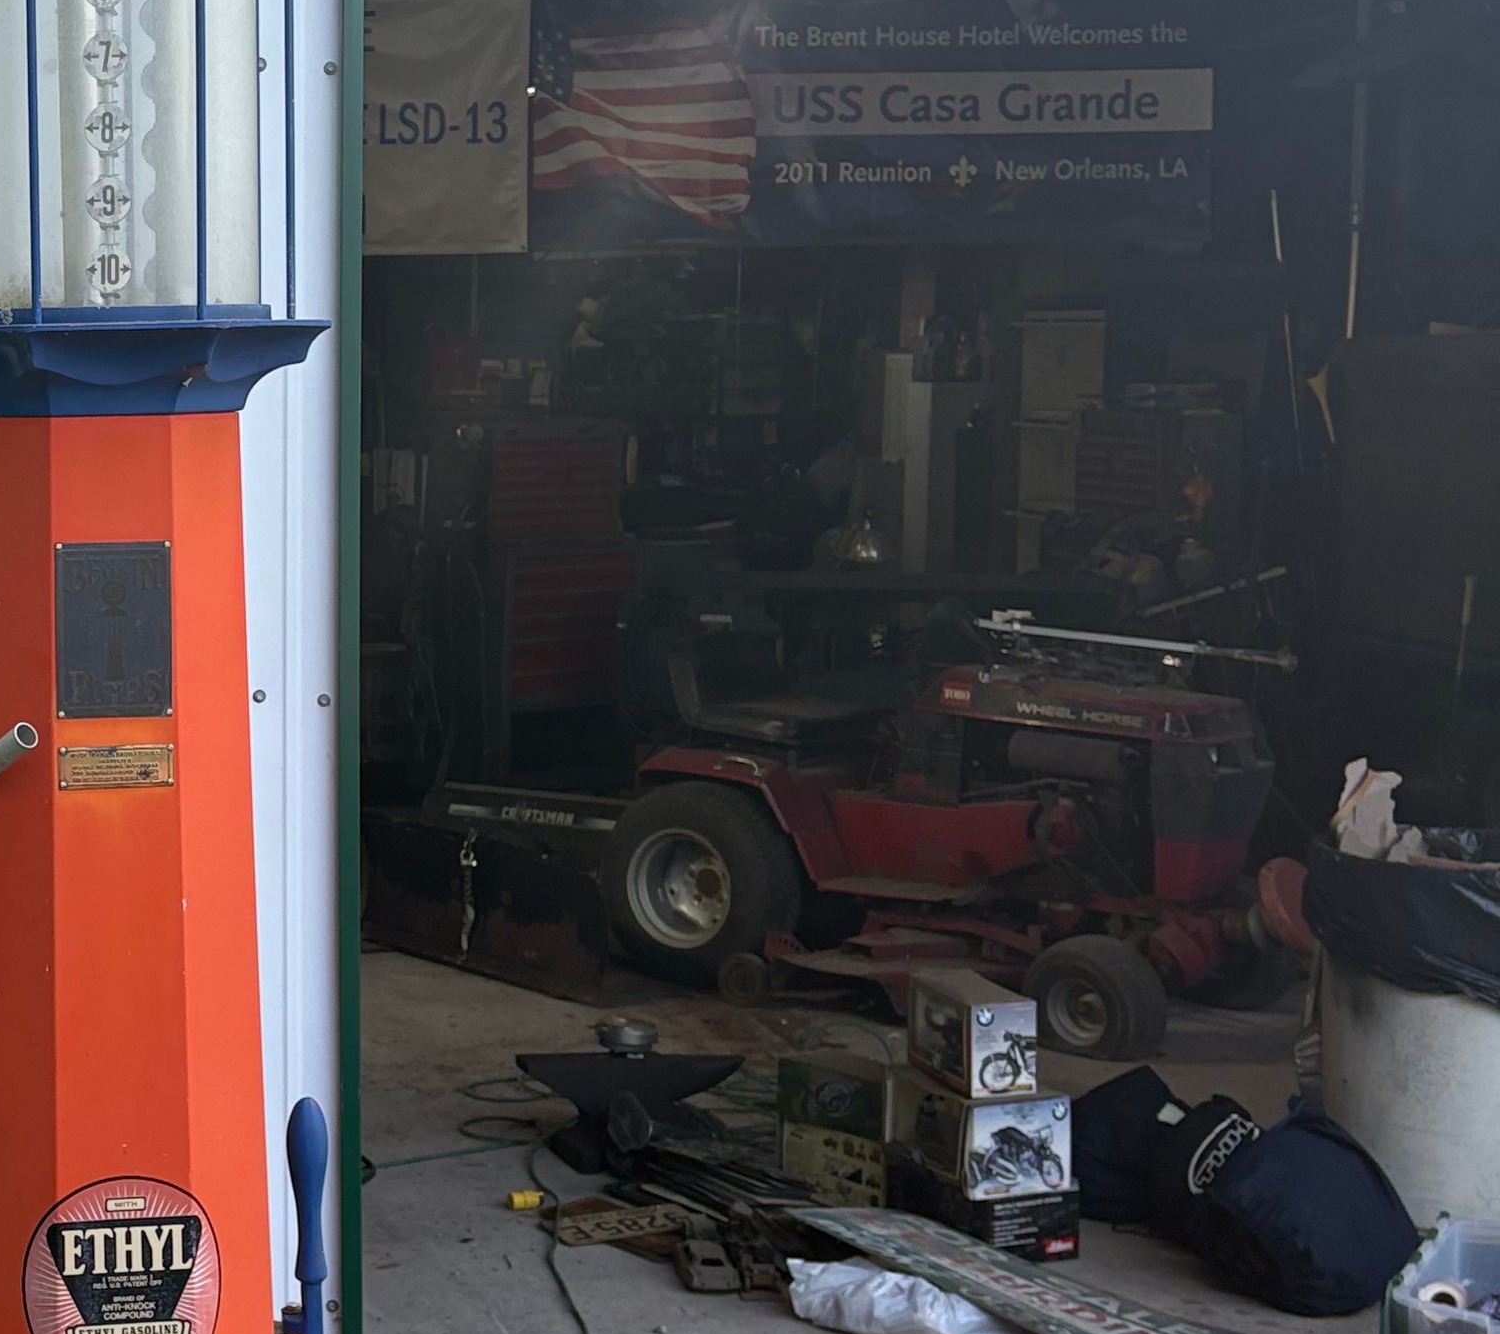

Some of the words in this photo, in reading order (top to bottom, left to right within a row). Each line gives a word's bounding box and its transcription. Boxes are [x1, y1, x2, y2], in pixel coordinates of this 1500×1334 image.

[755, 25, 799, 47] The
[807, 26, 867, 47] Brent
[876, 25, 950, 46] House
[959, 23, 1020, 46] Hotel
[1027, 22, 1143, 45] Welcomes
[1151, 21, 1188, 44] the
[99, 40, 112, 73] 7
[774, 84, 864, 124] USS
[880, 84, 981, 123] Casa
[998, 78, 1160, 122] Grande
[100, 111, 114, 144] 8
[379, 100, 508, 145] LSD-13
[775, 162, 828, 184] 2011
[839, 160, 932, 184] Reunion
[995, 160, 1048, 181] New
[1054, 157, 1150, 183] Orleans,
[1159, 157, 1189, 179] LA
[102, 185, 116, 217] 9
[99, 253, 120, 286] 10
[1016, 700, 1077, 720] WHEEL
[1082, 708, 1143, 728] HORSE
[501, 805, 575, 826] CRFTSMAN
[61, 1224, 193, 1277] ETHYL
[101, 1302, 156, 1312] ANTI-KNOCK
[103, 1311, 154, 1321] COMPOUND
